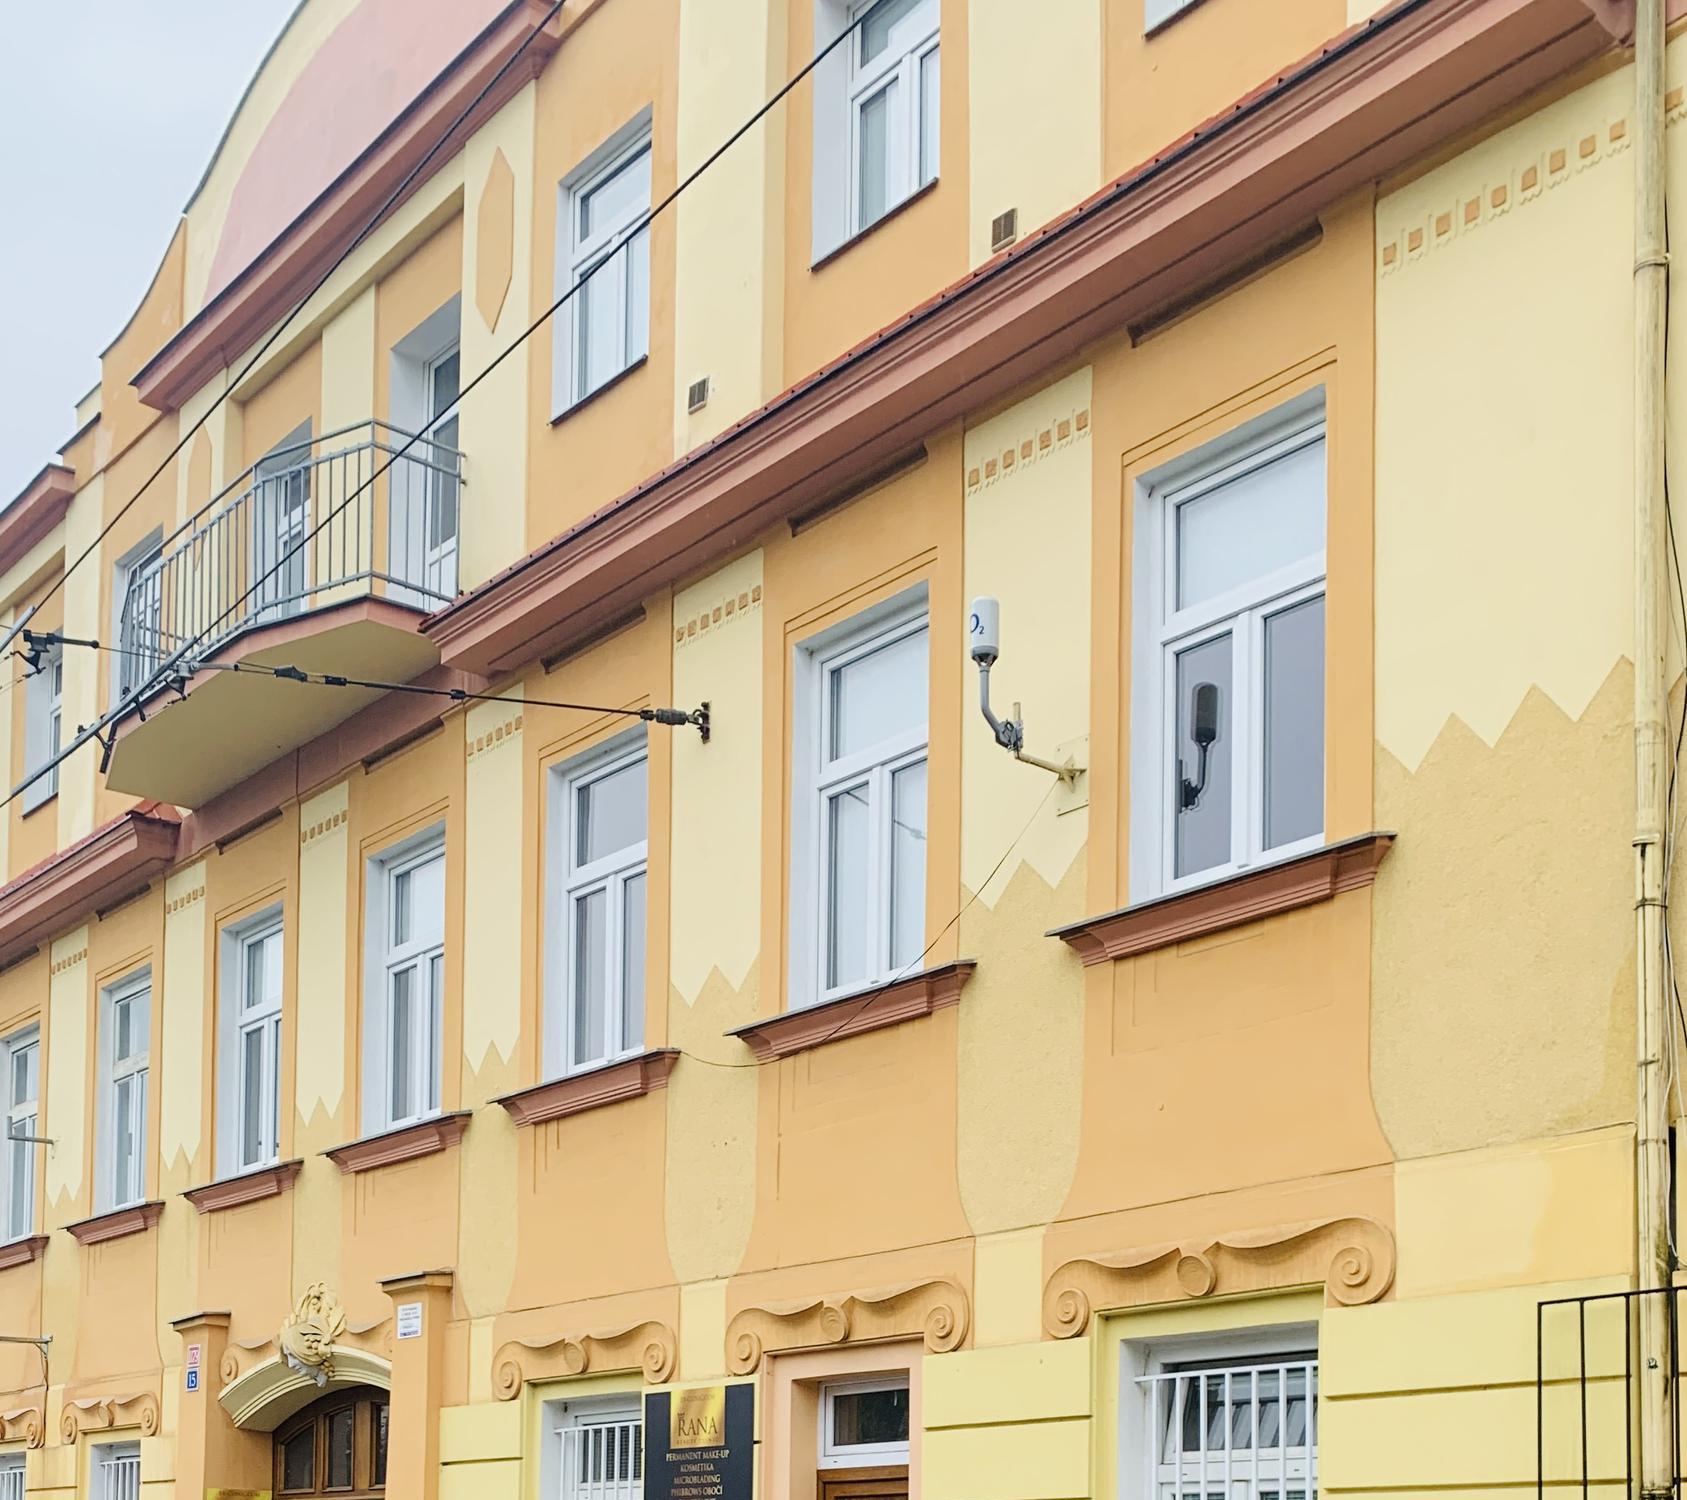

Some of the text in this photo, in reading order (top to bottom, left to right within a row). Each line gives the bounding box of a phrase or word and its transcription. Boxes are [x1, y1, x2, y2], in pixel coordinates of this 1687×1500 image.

[188, 1372, 196, 1387] 15
[665, 1449, 730, 1462] PERMANENT MAKE-UP
[680, 1463, 714, 1473] KOSMETIKA
[674, 1474, 720, 1484] MICROBLADING
